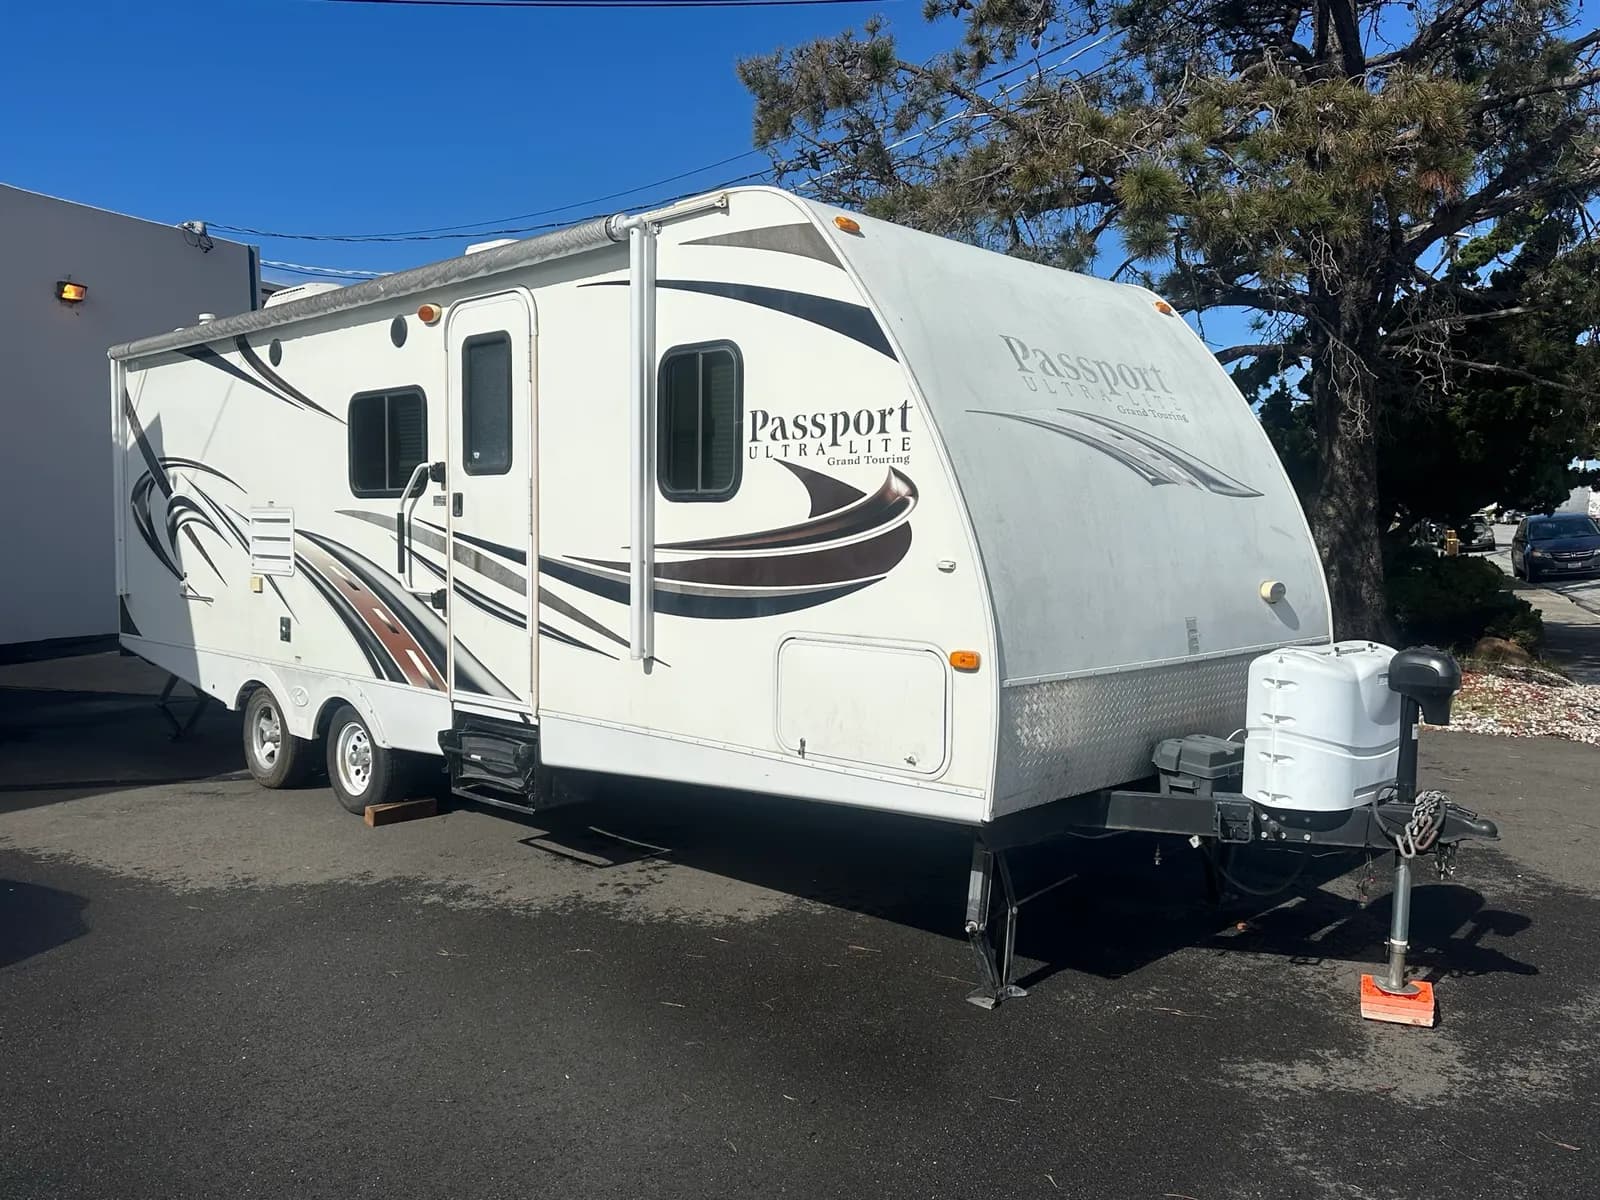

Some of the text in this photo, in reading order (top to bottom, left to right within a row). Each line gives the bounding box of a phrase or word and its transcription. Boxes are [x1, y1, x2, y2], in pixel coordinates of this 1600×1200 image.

[1000, 335, 1172, 396] Passport
[1022, 376, 1112, 402] ULTRA
[749, 400, 913, 447] Passport
[1117, 405, 1189, 423] Grand Touring
[749, 437, 911, 460] ULTRA LITE
[827, 454, 910, 466] Grand Touring
